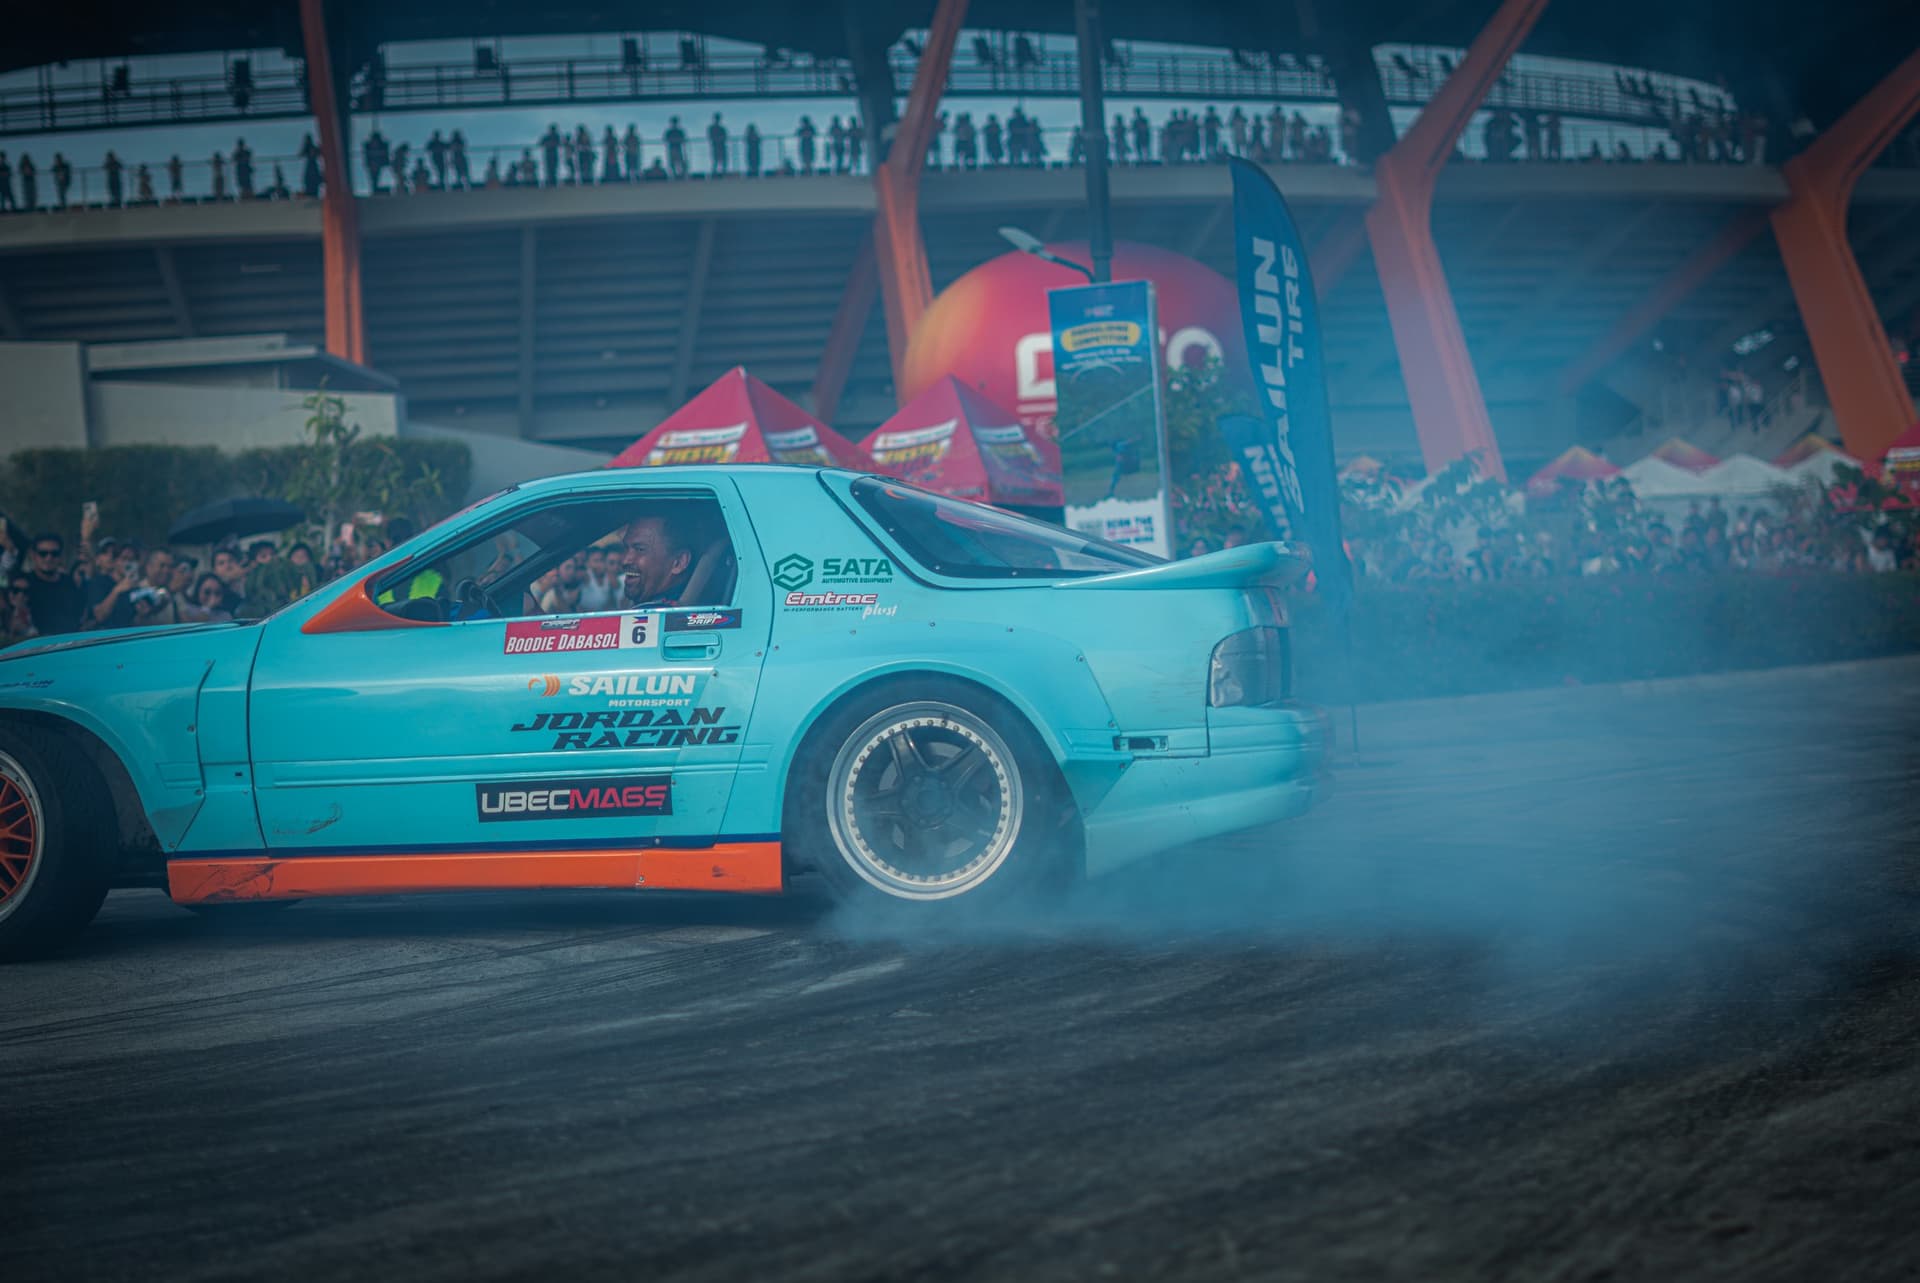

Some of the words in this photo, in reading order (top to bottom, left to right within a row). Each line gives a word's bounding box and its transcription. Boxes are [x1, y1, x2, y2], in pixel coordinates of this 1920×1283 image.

[1281, 243, 1305, 369] TIRE
[1252, 236, 1305, 514] SAILUN
[822, 558, 893, 576] SATA
[785, 591, 879, 606] Emtrac
[506, 636, 557, 653] BOODIE
[559, 631, 618, 652] DABASOL
[631, 625, 646, 645] 6
[568, 676, 696, 695] SAILUN
[608, 698, 692, 708] MOTORSPORT
[511, 706, 726, 732] JORDAN
[552, 725, 742, 750] RACING
[481, 785, 668, 813] UBECMAGS
